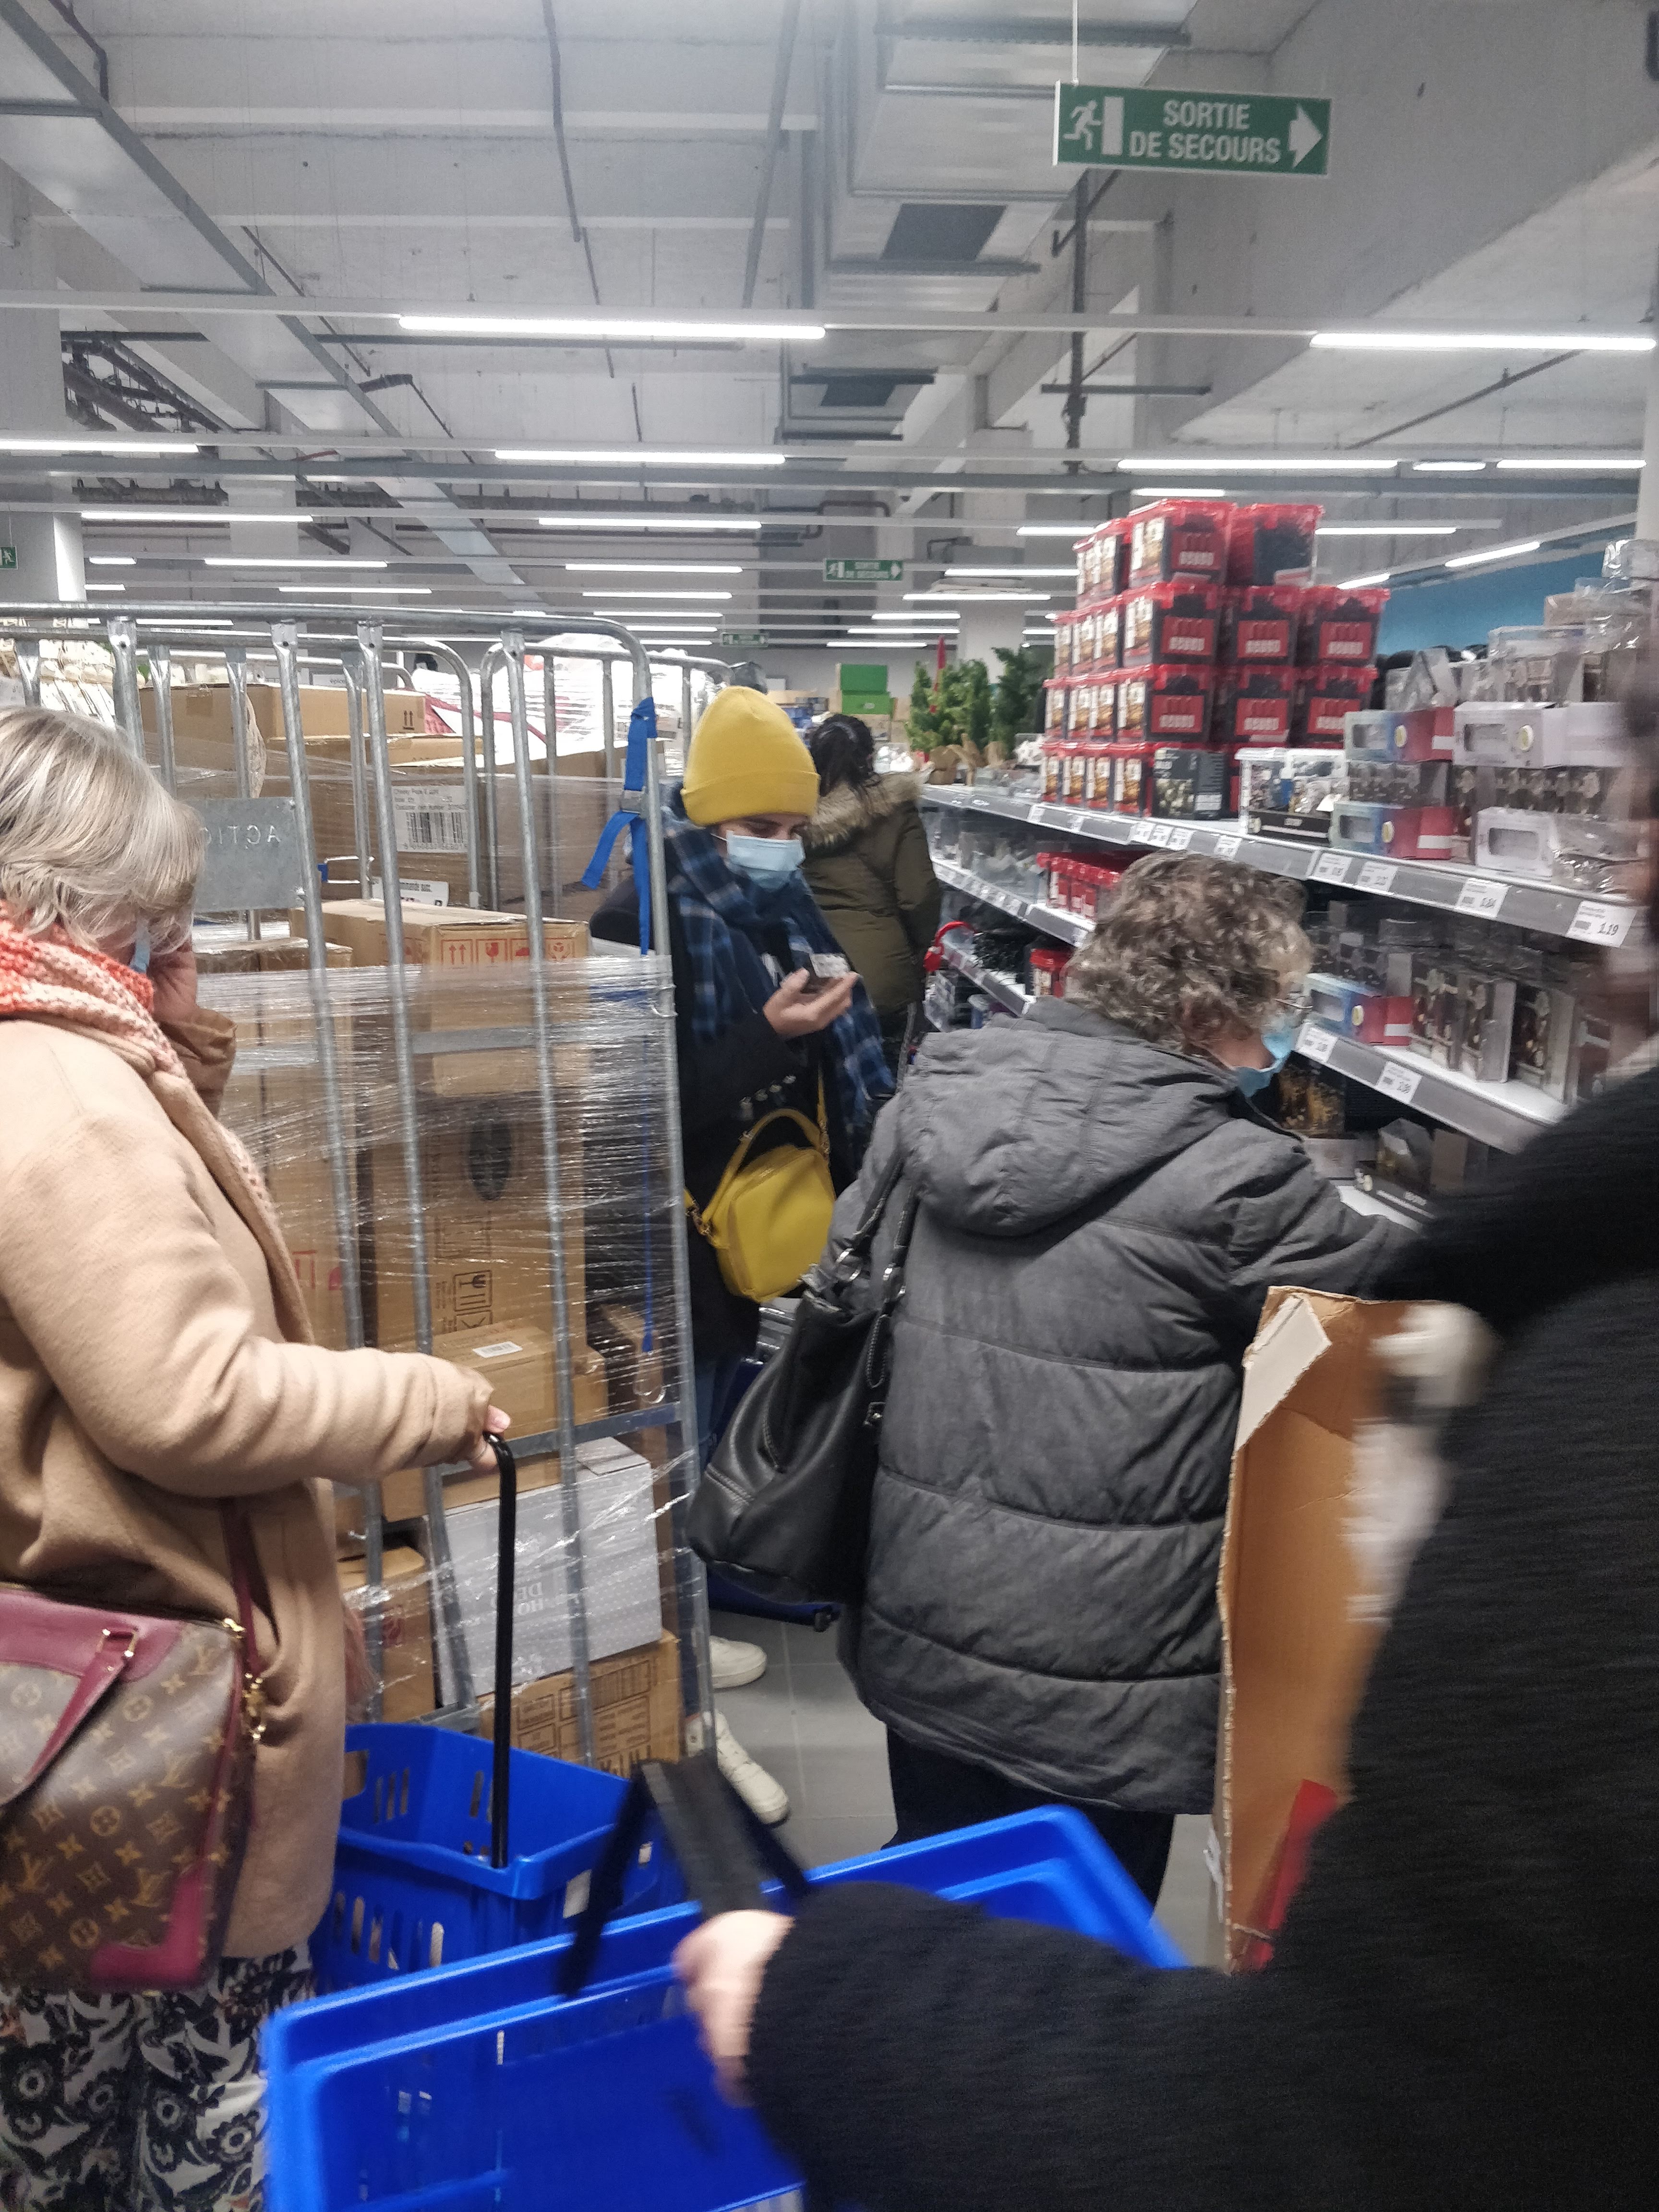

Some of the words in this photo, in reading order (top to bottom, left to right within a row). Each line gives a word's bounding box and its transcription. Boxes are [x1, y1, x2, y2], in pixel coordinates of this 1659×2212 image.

[1163, 99, 1250, 130] SORTIE
[1129, 131, 1162, 157] DE
[1168, 134, 1281, 164] SECOURS
